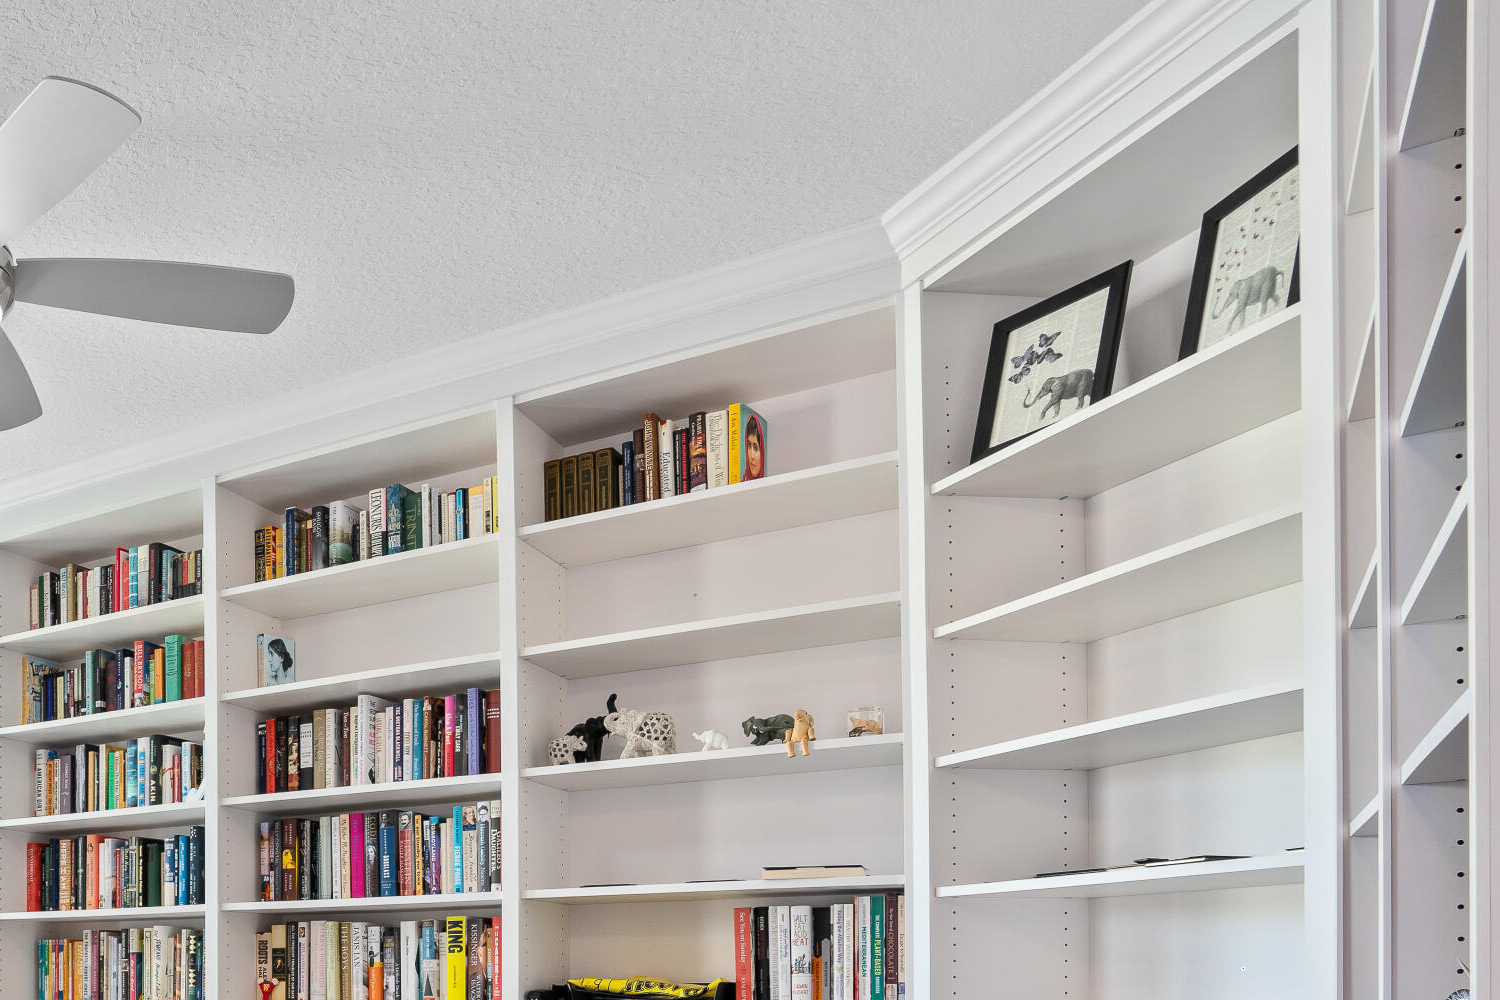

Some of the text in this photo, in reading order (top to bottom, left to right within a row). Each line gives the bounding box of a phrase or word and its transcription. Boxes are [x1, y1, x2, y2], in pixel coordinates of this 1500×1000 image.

[662, 452, 672, 493] Educated
[60, 876, 66, 890] AM
[340, 926, 348, 970] THE BOYS
[448, 920, 464, 954] KING
[793, 938, 808, 946] HEAT
[258, 940, 268, 964] ROOTS
